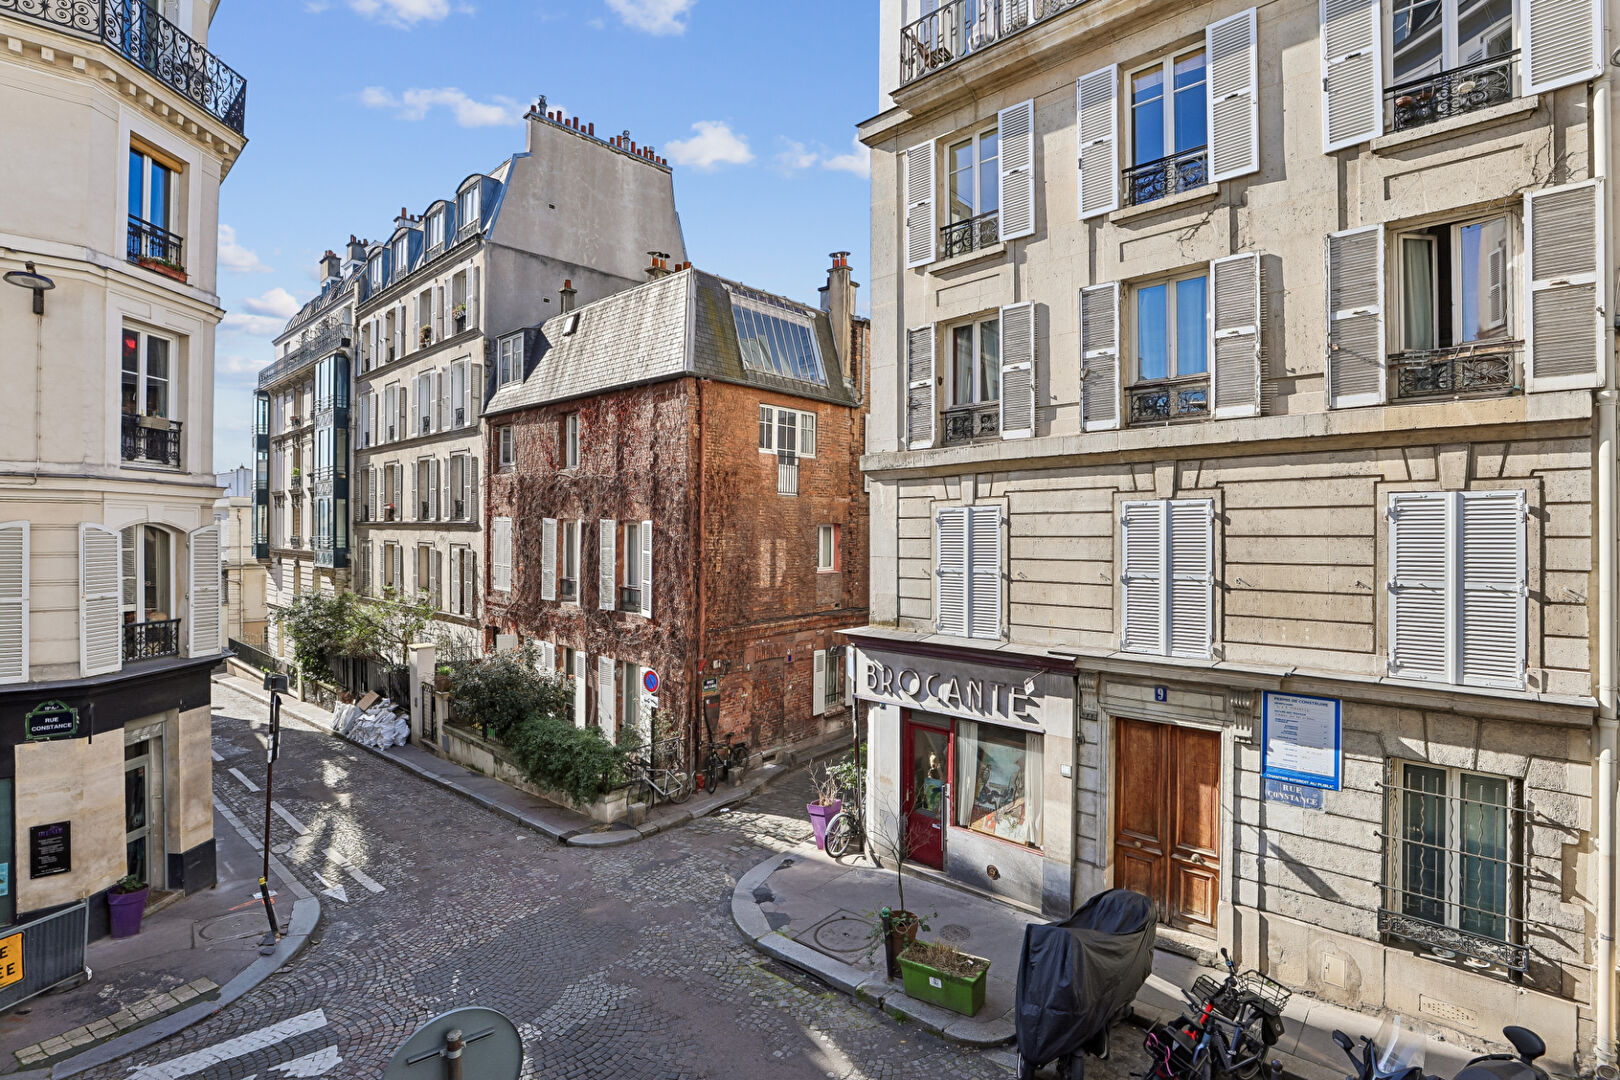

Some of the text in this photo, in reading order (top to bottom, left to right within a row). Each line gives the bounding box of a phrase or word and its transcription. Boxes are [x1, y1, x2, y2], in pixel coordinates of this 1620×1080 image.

[866, 663, 1031, 717] BROCANTE
[1157, 687, 1164, 701] 9
[31, 722, 73, 732] CONSTANCE
[1282, 784, 1303, 794] RUE
[1267, 790, 1318, 806] CONSTANCE
